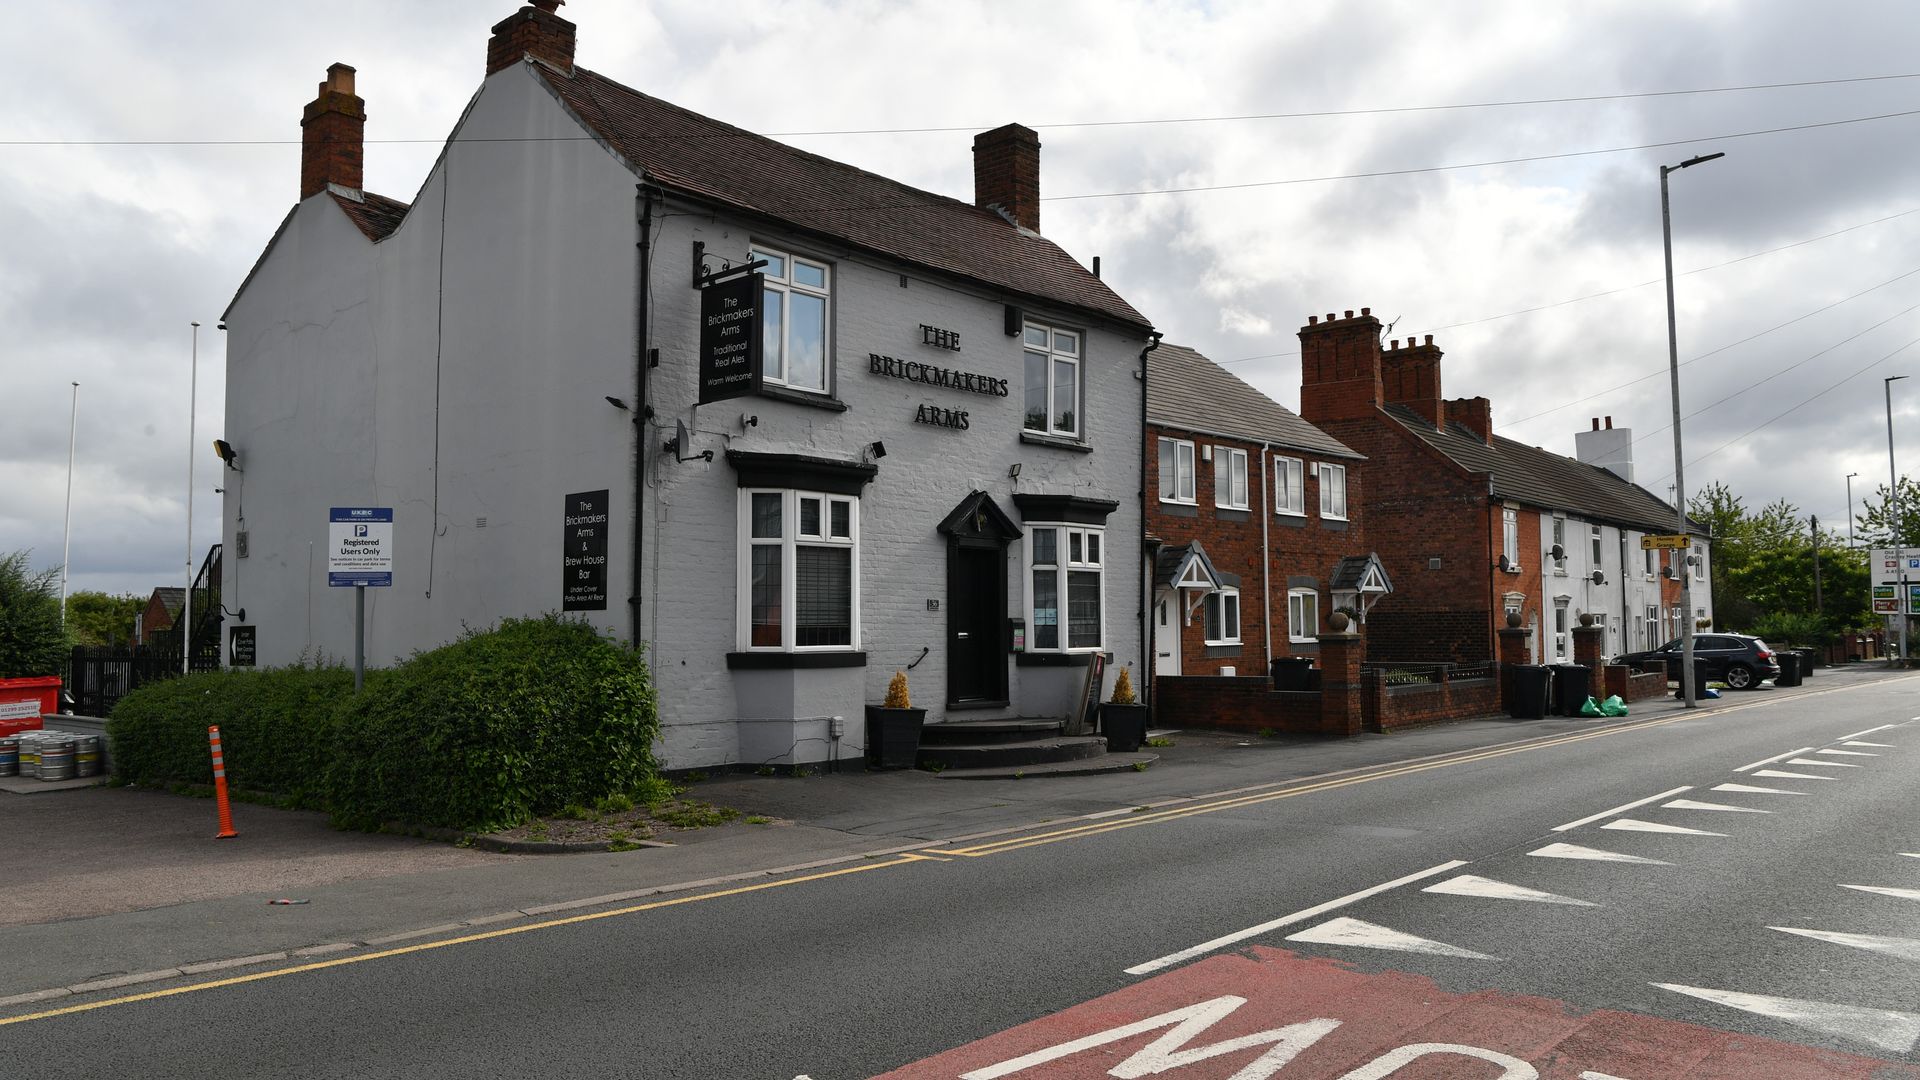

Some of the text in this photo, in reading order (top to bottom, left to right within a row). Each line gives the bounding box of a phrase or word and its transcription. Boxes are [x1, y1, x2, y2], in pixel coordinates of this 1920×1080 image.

[724, 298, 738, 309] The
[708, 308, 754, 326] Brickmakers
[720, 325, 740, 337] Arms
[919, 323, 961, 352] THE
[713, 340, 748, 356] Traditional
[715, 355, 745, 368] Real Ales
[707, 372, 753, 386] Warm Welcome
[868, 353, 1009, 397] BRICKMAKERS
[914, 404, 970, 430] ARMS
[580, 501, 592, 511] The
[566, 514, 606, 526] Brickmakers
[576, 528, 594, 538] Arms
[582, 541, 588, 551] &
[565, 555, 605, 566] Brew House
[578, 569, 590, 579] Bar
[583, 585, 598, 593] Cover
